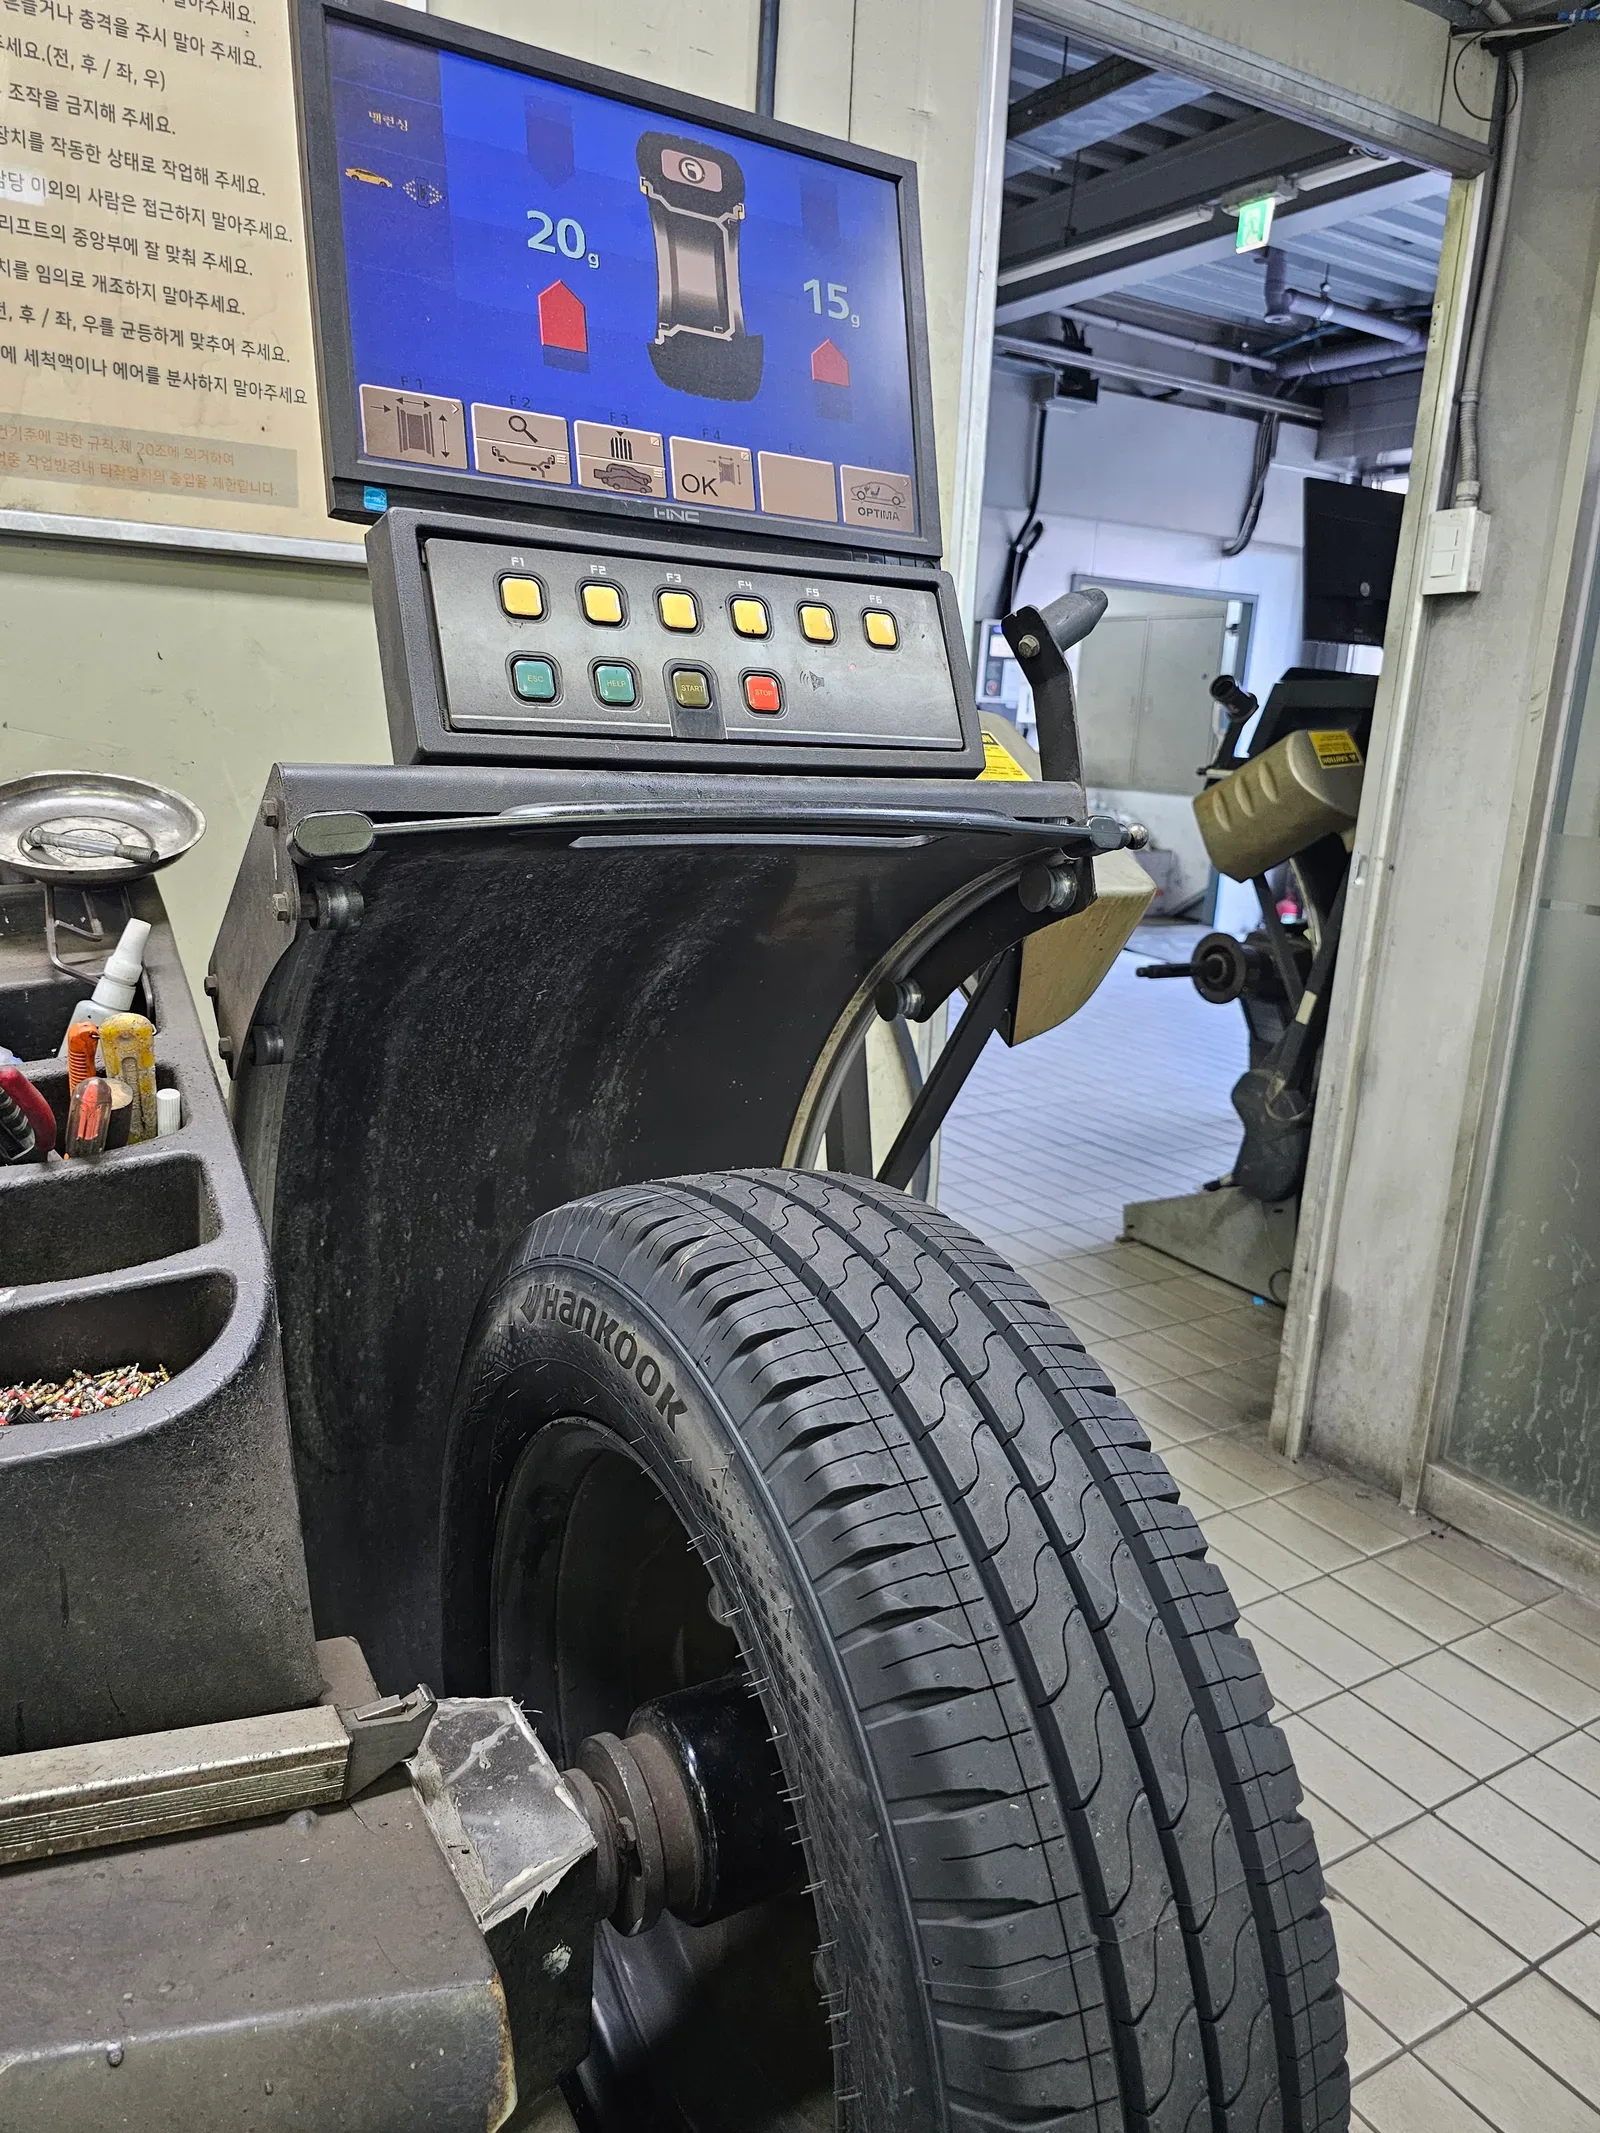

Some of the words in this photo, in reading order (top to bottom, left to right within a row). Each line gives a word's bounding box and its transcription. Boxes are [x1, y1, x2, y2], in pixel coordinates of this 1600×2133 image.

[79, 9, 130, 38] 충격을
[135, 22, 166, 48] 주시
[174, 31, 206, 56] 말아
[210, 41, 262, 68] 주세요.
[80, 54, 98, 74] 후
[102, 58, 111, 79] /
[116, 62, 138, 86] 좌,
[143, 69, 166, 92] 우)
[8, 82, 60, 112] 조작을
[66, 94, 116, 124] 금지해
[122, 107, 176, 135] 주세요.
[0, 126, 44, 153] 장치를
[51, 136, 101, 164] 작동한
[108, 148, 156, 174] 상태로
[162, 159, 209, 186] 작업해
[214, 170, 266, 196] 주세요.
[31, 177, 80, 204] 이외의
[88, 188, 136, 214] 사람은
[142, 198, 206, 228] 접근하지
[212, 211, 293, 243] 말아주세요.
[0, 214, 66, 244] 리프트의
[72, 227, 138, 256] 중앙부에
[144, 240, 160, 261] 잘
[166, 244, 196, 268] 맞춰
[202, 251, 253, 276] 주세요.
[36, 264, 86, 288] 임의로
[92, 274, 156, 302] 개조하지
[162, 285, 245, 316] 말아주세요.
[19, 304, 36, 324] 후
[42, 308, 50, 328] /
[56, 310, 76, 332] 좌,
[82, 315, 115, 337] 우를
[120, 320, 184, 347] 균등하게
[190, 331, 235, 356] 맞추어
[241, 340, 290, 363] 주세요.
[0, 345, 17, 364] 에
[24, 348, 108, 378] 세척액이나
[112, 360, 161, 386] 에어를
[166, 369, 228, 394] 분사하지
[234, 378, 308, 404] 말아주세요
[56, 431, 83, 449] 관한
[120, 440, 132, 454] 제
[184, 448, 234, 467] 의거하여
[681, 473, 719, 498] OK
[857, 506, 900, 522] OPTIMA
[511, 556, 525, 568] F1
[590, 565, 606, 575] F2
[666, 572, 682, 583] F3
[737, 580, 753, 590] F4
[806, 588, 820, 598] F5
[869, 595, 883, 604] F6
[527, 674, 544, 682] ESC
[606, 680, 626, 688] HELP
[681, 684, 704, 692] START
[754, 688, 773, 697] STOP
